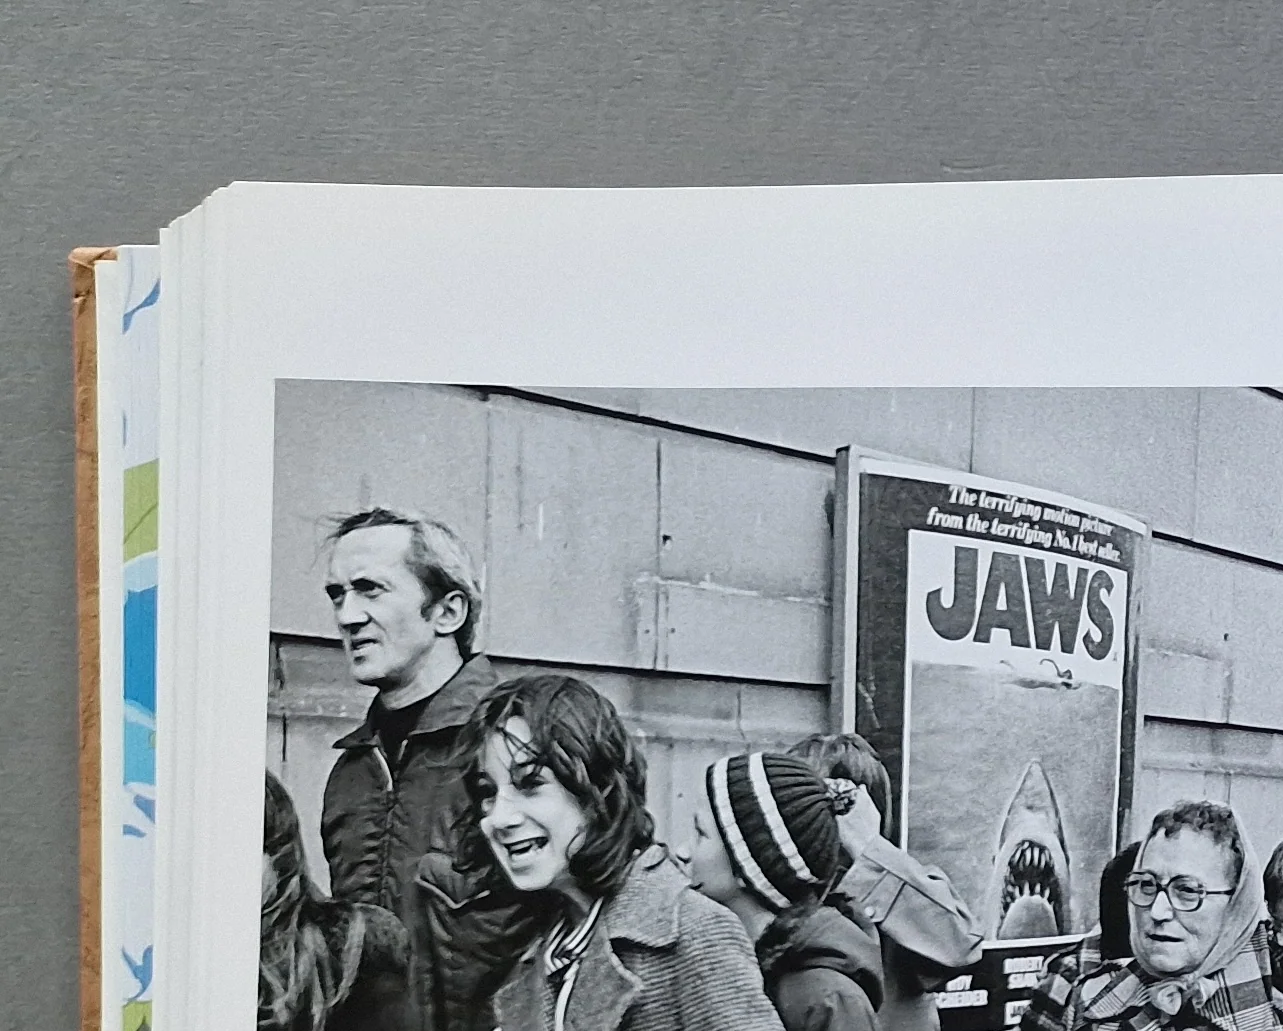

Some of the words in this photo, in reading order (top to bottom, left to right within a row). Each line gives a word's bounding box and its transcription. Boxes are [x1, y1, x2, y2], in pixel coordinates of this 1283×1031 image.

[949, 486, 977, 507] The
[978, 492, 1042, 521] terrifying
[1043, 505, 1080, 527] motion
[926, 507, 963, 529] from
[965, 512, 989, 534] the
[991, 517, 1053, 548] terrifying
[926, 546, 1114, 660] JAWS
